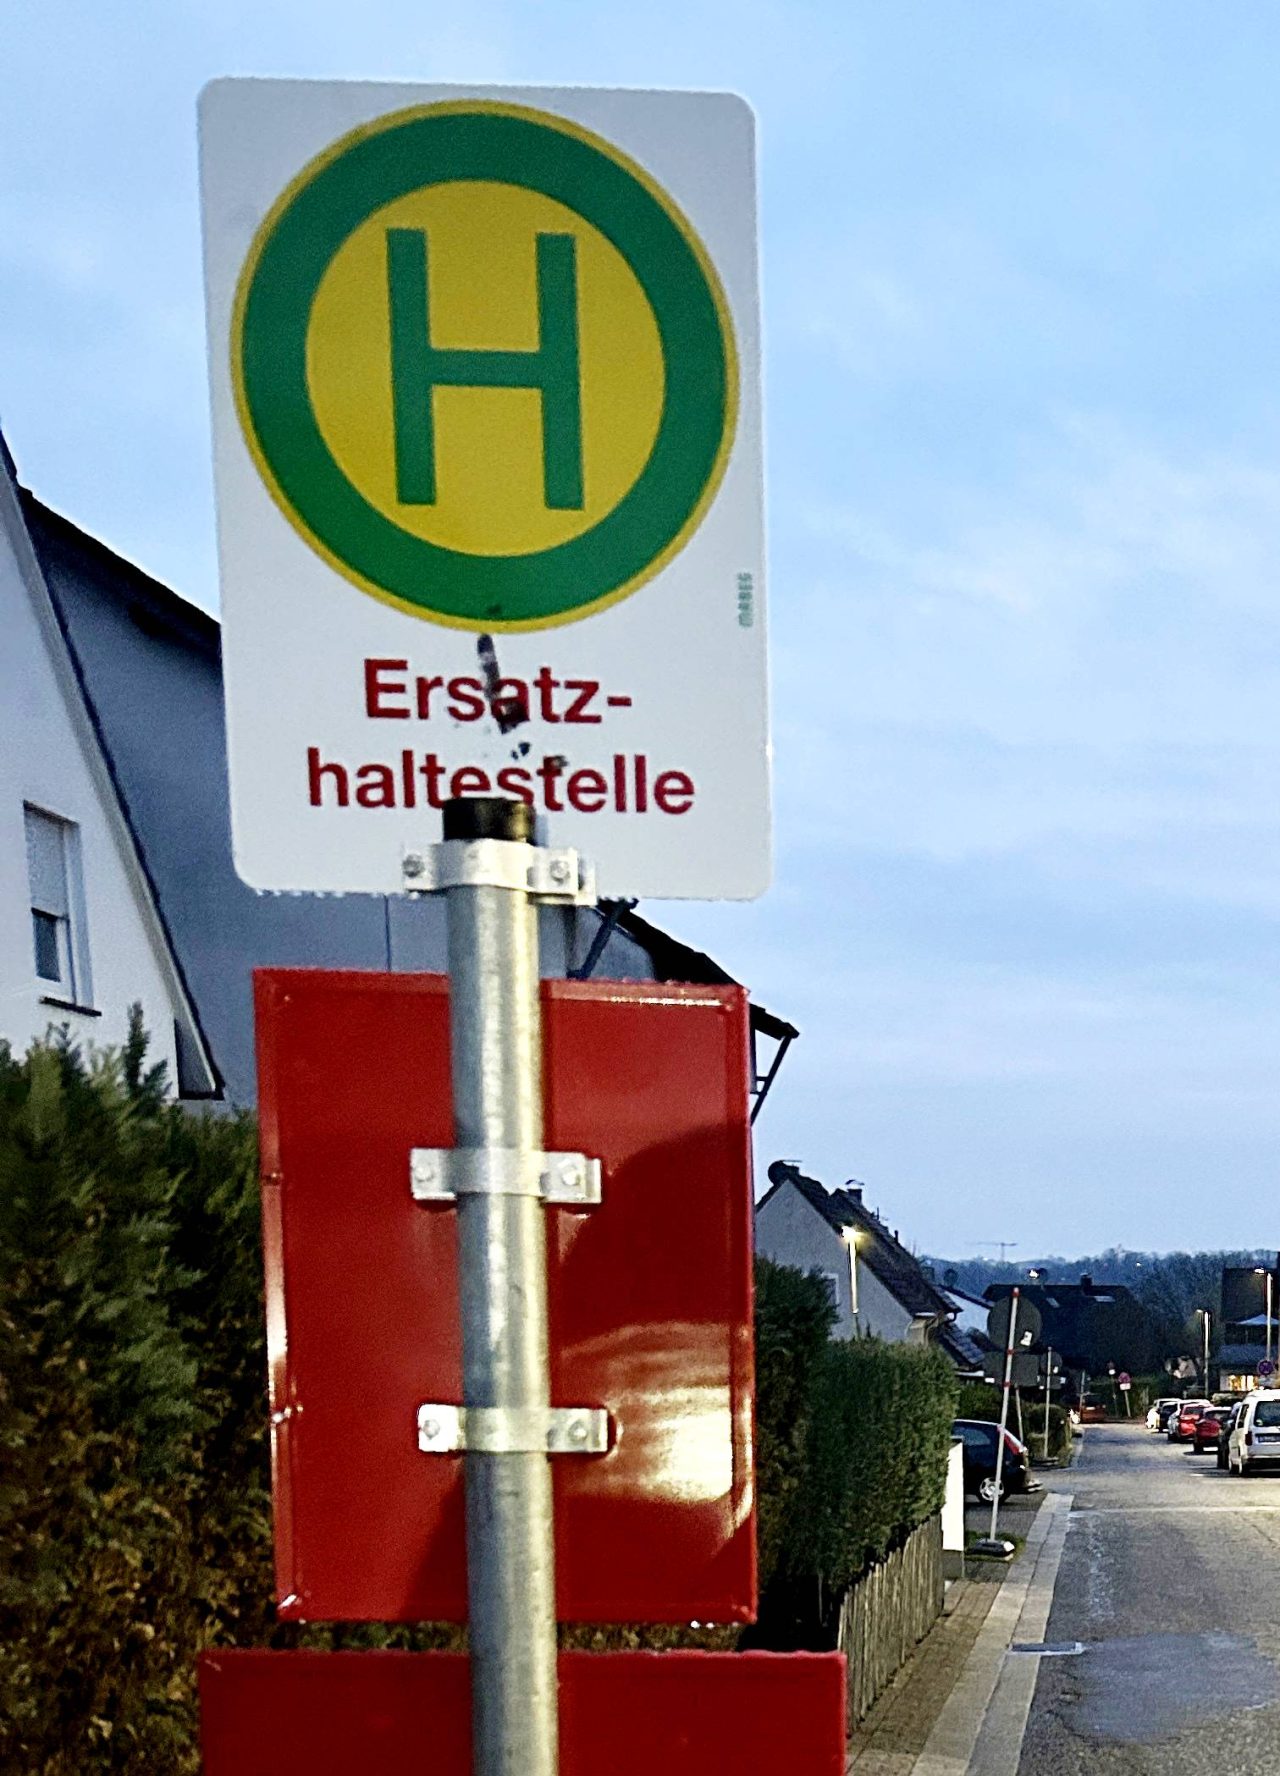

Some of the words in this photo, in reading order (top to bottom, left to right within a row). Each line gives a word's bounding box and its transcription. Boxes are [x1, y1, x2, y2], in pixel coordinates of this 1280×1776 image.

[385, 226, 585, 511] H
[364, 658, 633, 725] Ersatz-
[307, 746, 696, 815] haltestelle
